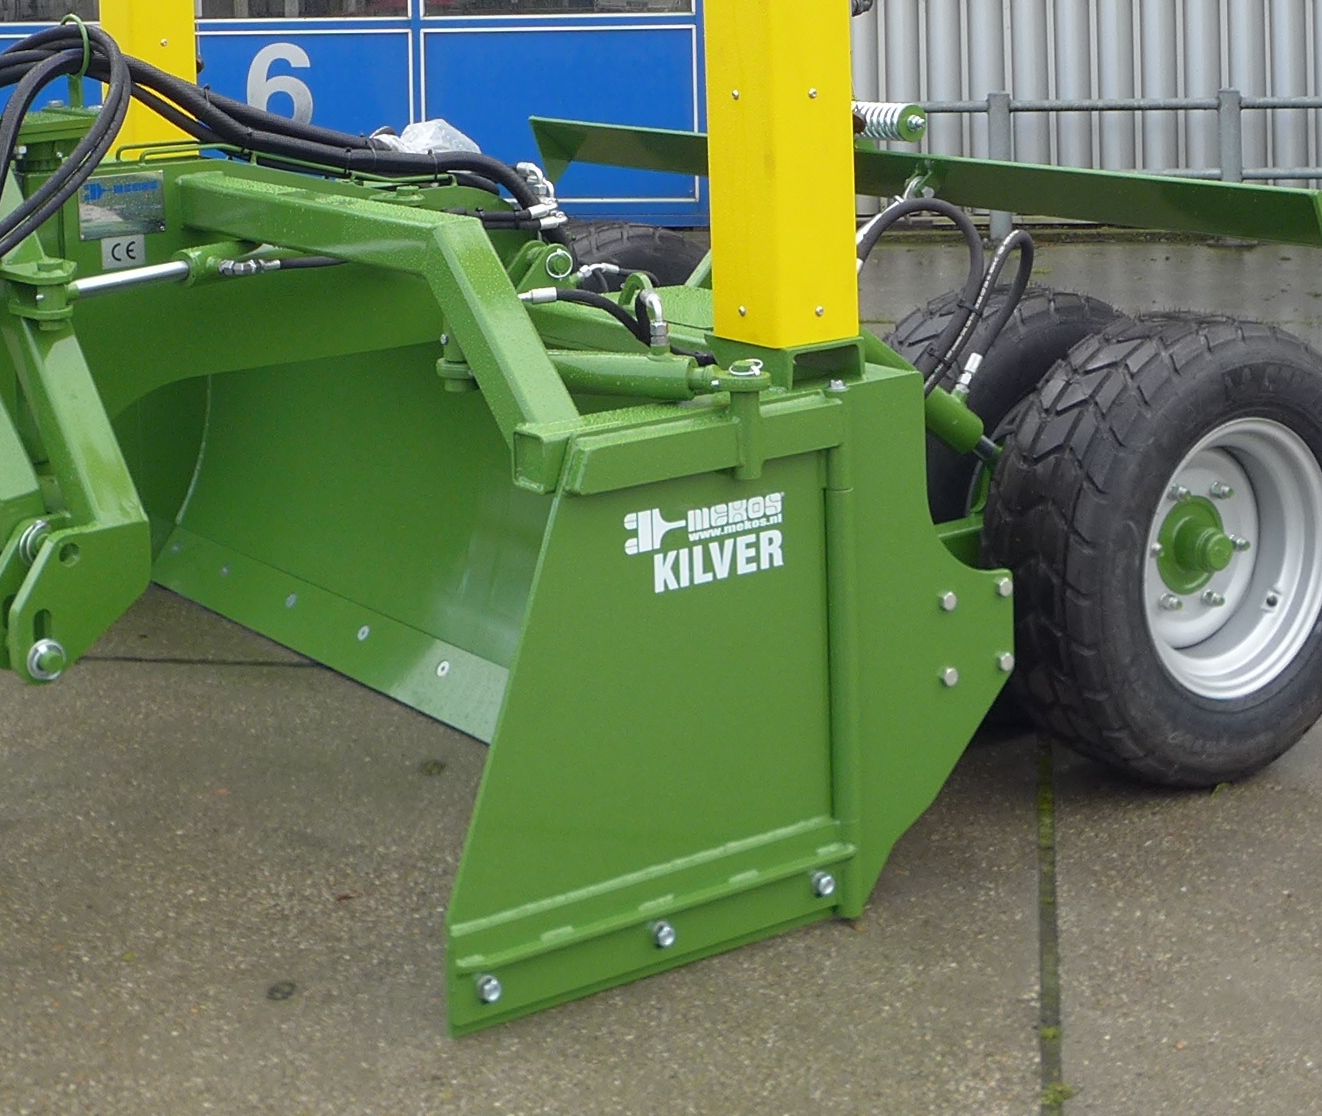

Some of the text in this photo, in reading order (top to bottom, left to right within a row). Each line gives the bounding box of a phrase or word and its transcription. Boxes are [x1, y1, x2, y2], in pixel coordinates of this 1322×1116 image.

[245, 42, 314, 125] 6
[111, 240, 136, 262] CE
[688, 513, 783, 542] www.mekos.nl
[653, 530, 784, 594] KILVER
